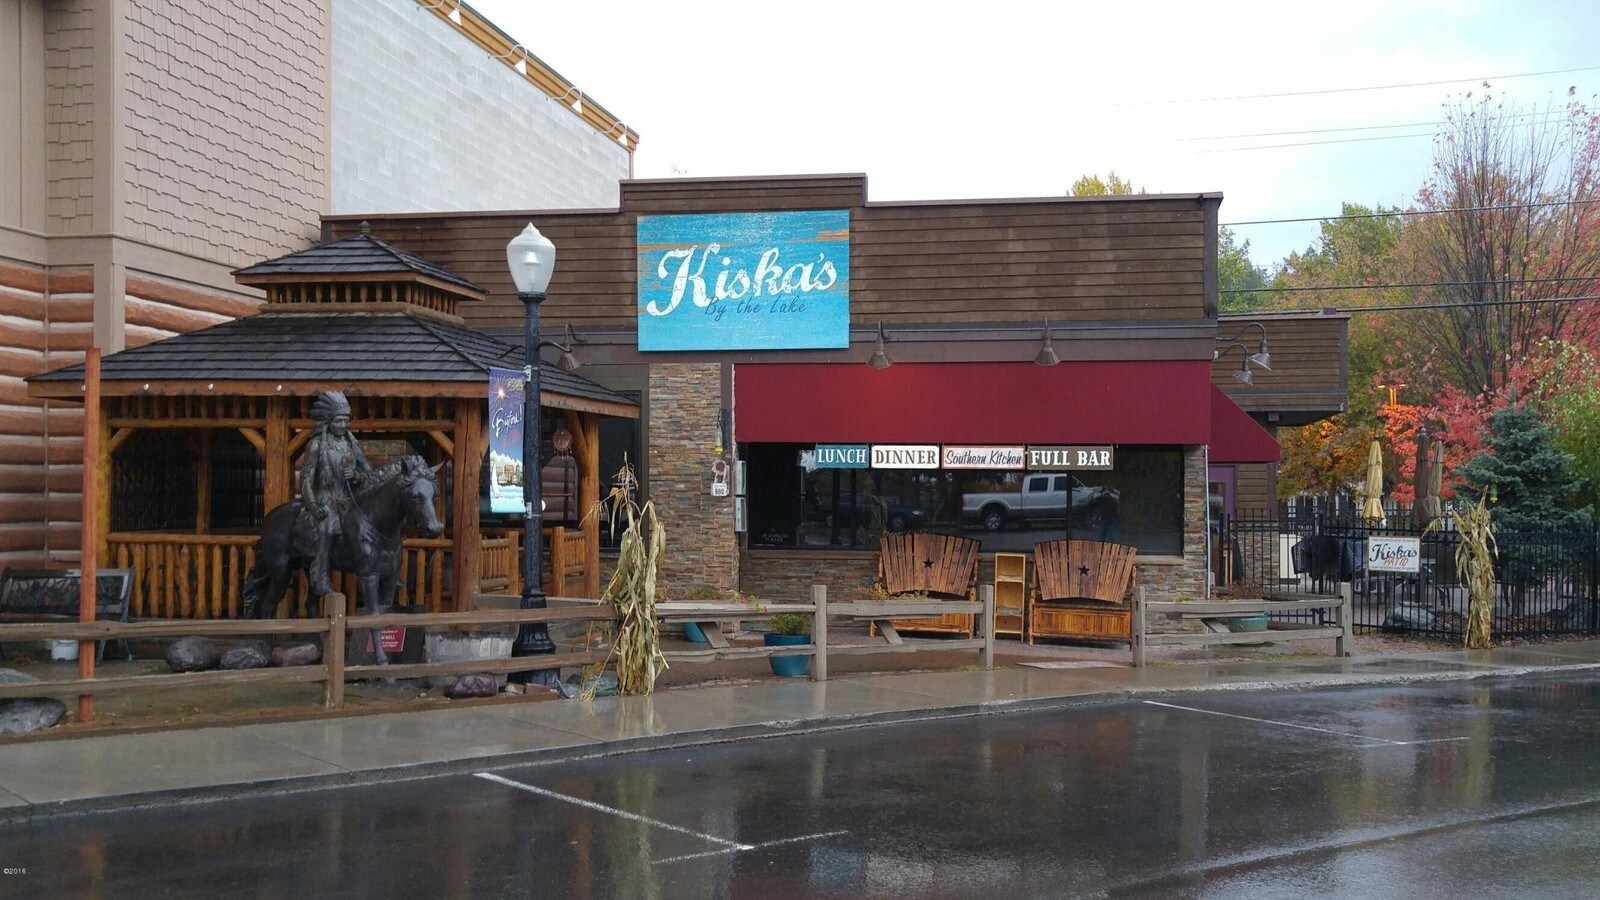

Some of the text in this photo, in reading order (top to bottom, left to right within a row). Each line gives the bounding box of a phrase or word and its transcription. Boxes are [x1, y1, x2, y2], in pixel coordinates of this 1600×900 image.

[646, 242, 838, 316] Kiska's
[705, 296, 806, 321] By the Lake
[817, 448, 867, 464] LUNCH
[874, 449, 937, 465] DINNER
[944, 449, 1022, 465] Southern Kitchen
[1030, 450, 1111, 466] FULL BAR
[1369, 543, 1418, 562] Kiska's
[1384, 557, 1409, 566] PATIO
